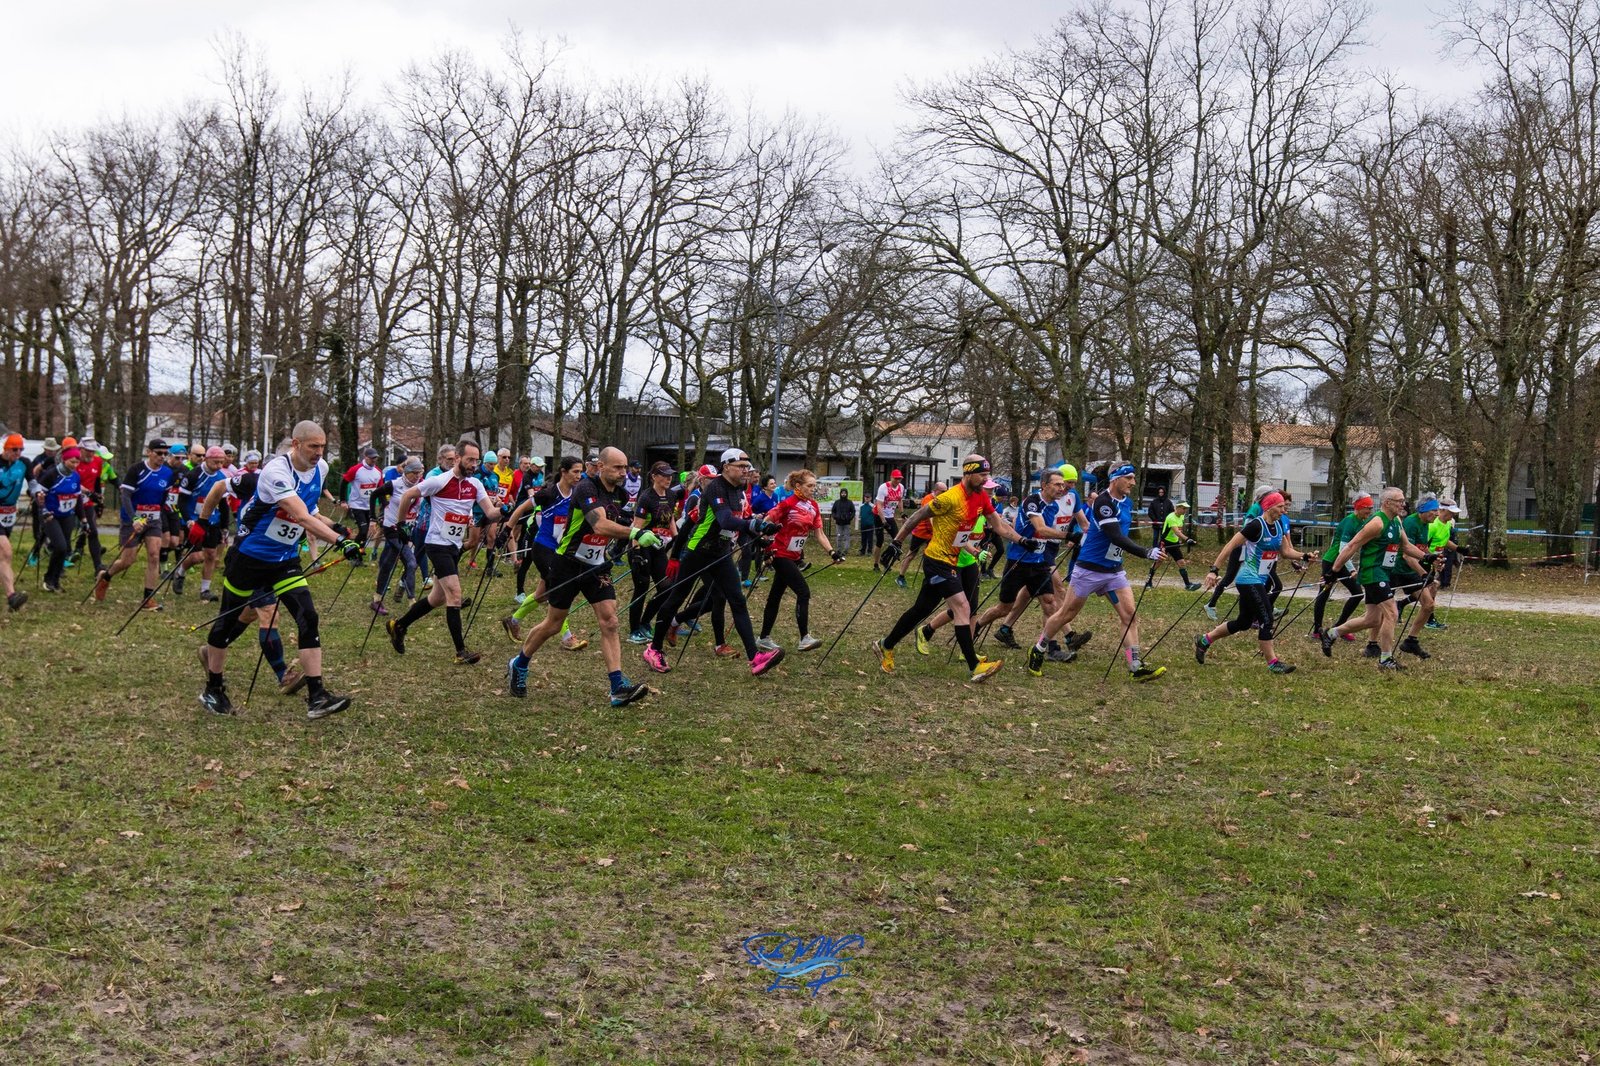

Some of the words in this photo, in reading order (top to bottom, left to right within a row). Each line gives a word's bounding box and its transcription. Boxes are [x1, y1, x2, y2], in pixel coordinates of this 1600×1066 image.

[62, 501, 73, 510] 11
[278, 524, 298, 540] 35
[448, 525, 463, 537] 32
[795, 539, 804, 548] 19
[585, 548, 601, 560] 31
